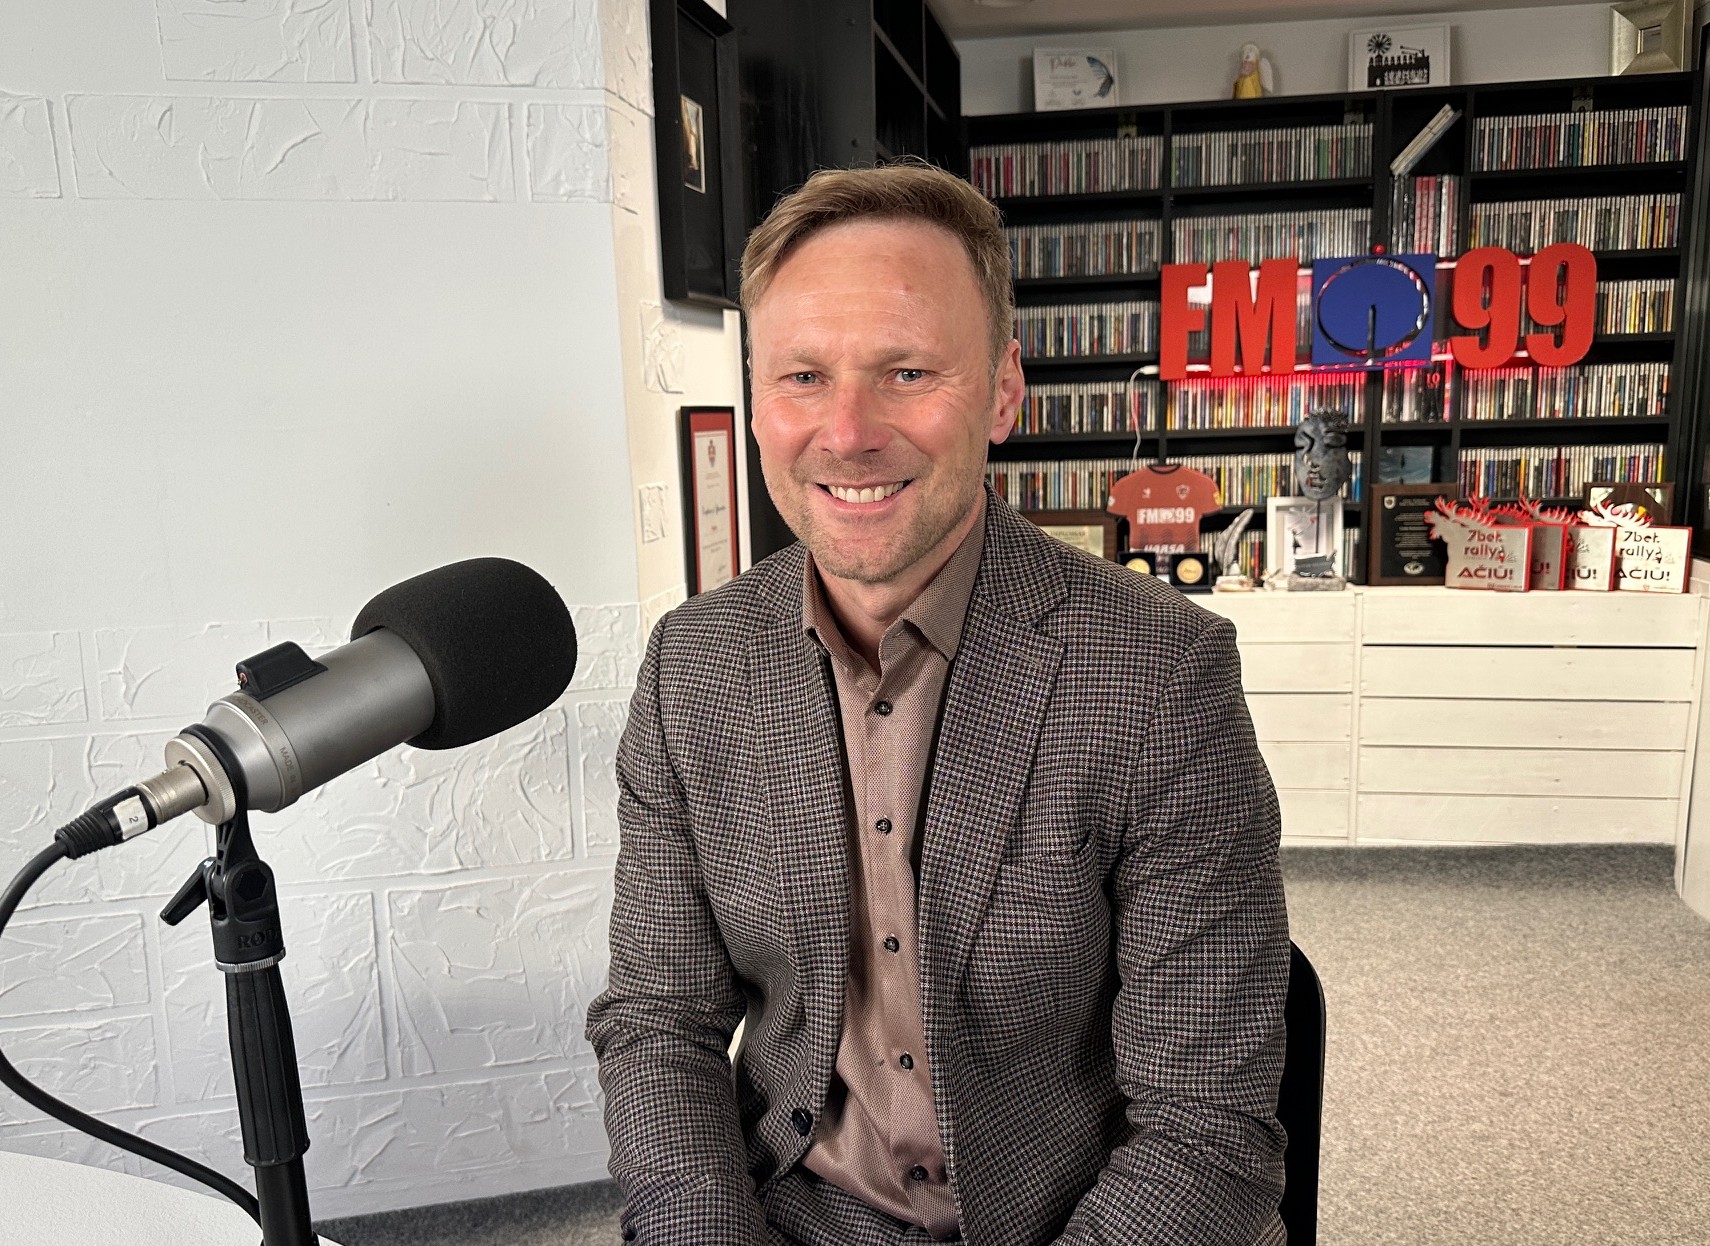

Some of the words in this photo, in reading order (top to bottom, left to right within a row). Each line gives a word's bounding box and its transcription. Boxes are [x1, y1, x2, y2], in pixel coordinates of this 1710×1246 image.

[1160, 257, 1299, 381] FM
[1451, 242, 1598, 369] 99
[1619, 545, 1654, 560] rally
[129, 815, 139, 824] 2
